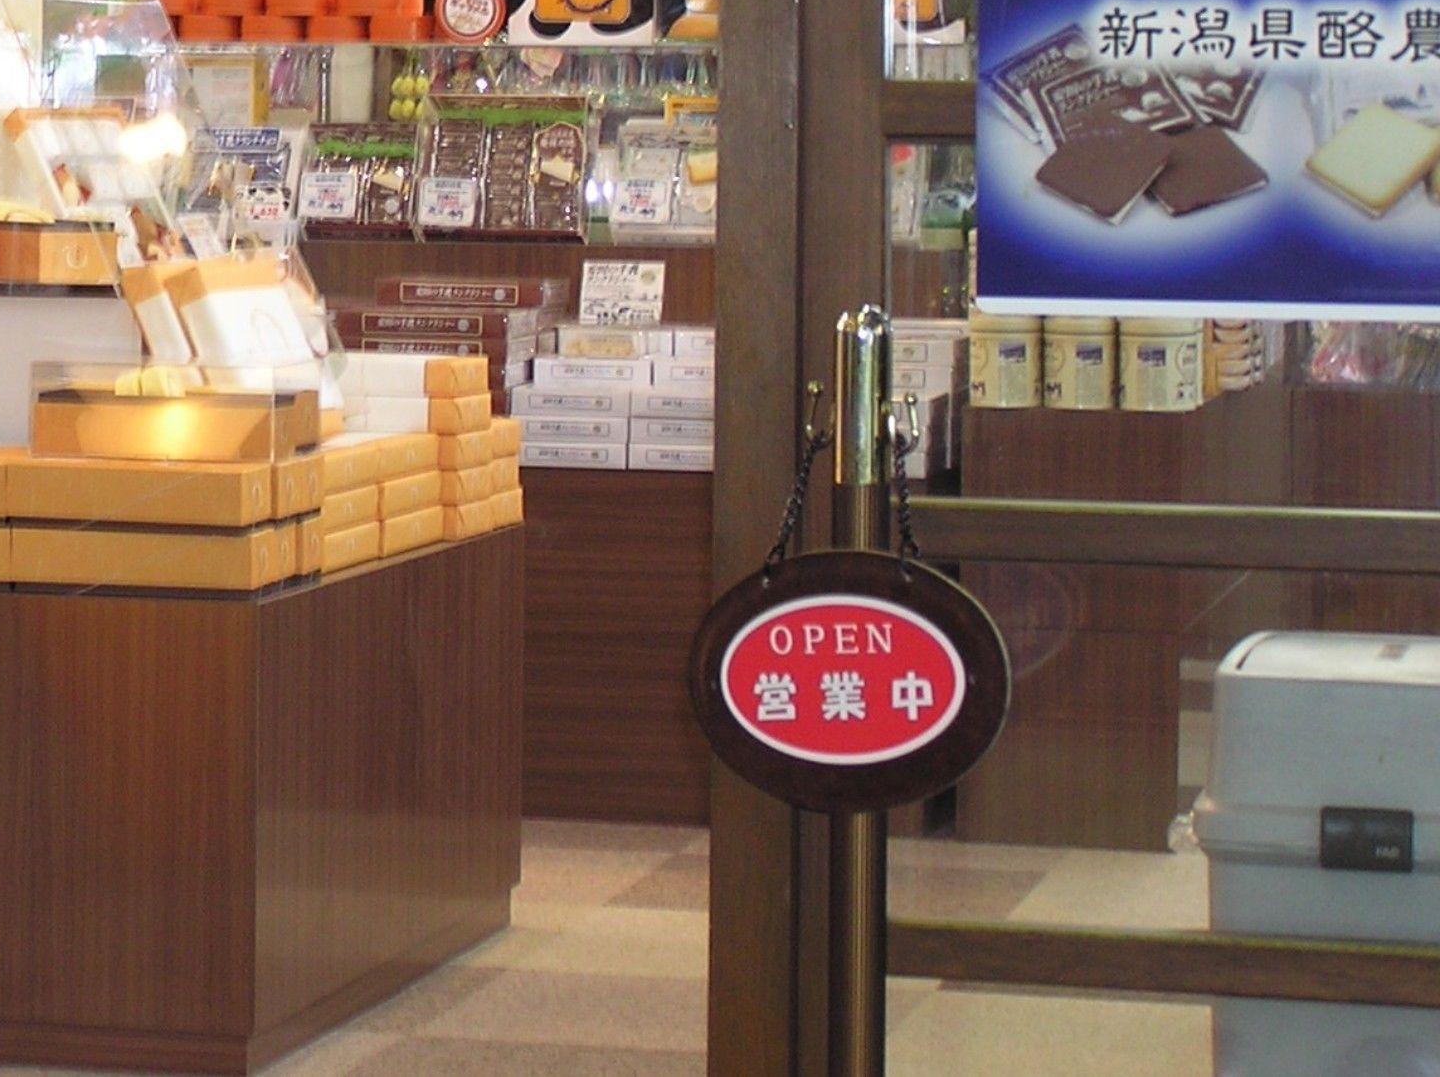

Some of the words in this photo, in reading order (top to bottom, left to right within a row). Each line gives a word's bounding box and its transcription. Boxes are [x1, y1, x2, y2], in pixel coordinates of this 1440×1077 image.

[769, 624, 893, 655] OPEN
[753, 671, 934, 721] 営業中
